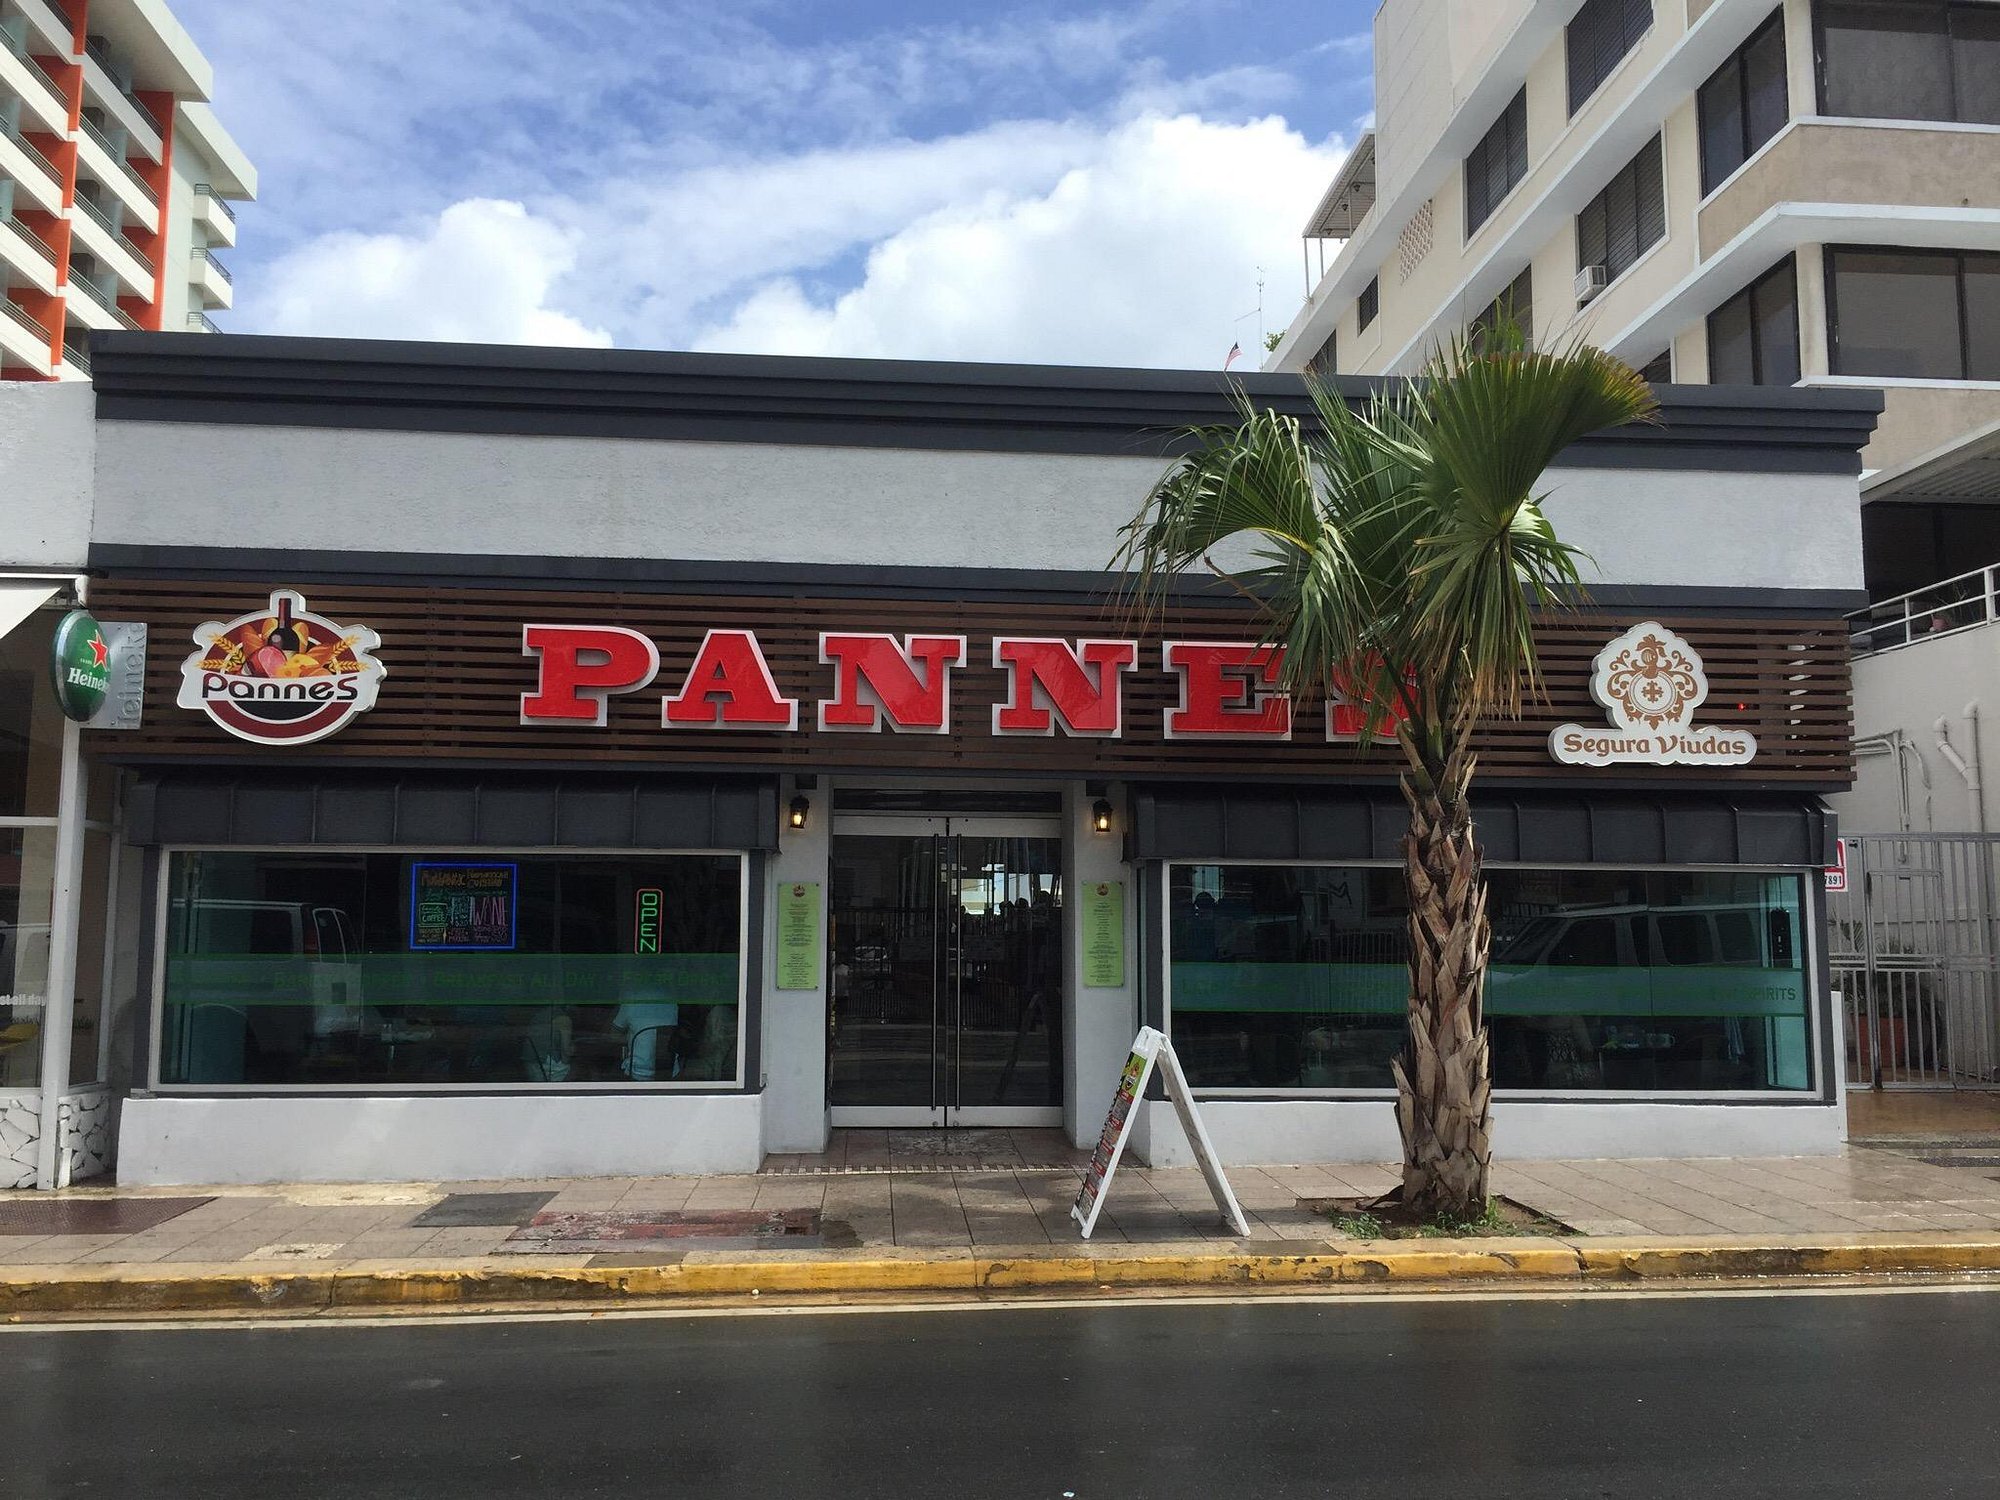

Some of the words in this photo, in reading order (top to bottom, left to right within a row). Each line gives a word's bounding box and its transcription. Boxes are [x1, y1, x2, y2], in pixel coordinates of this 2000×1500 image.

[1563, 733, 1651, 757] Segura
[1655, 734, 1747, 755] Viudas
[640, 893, 658, 952] OPEN
